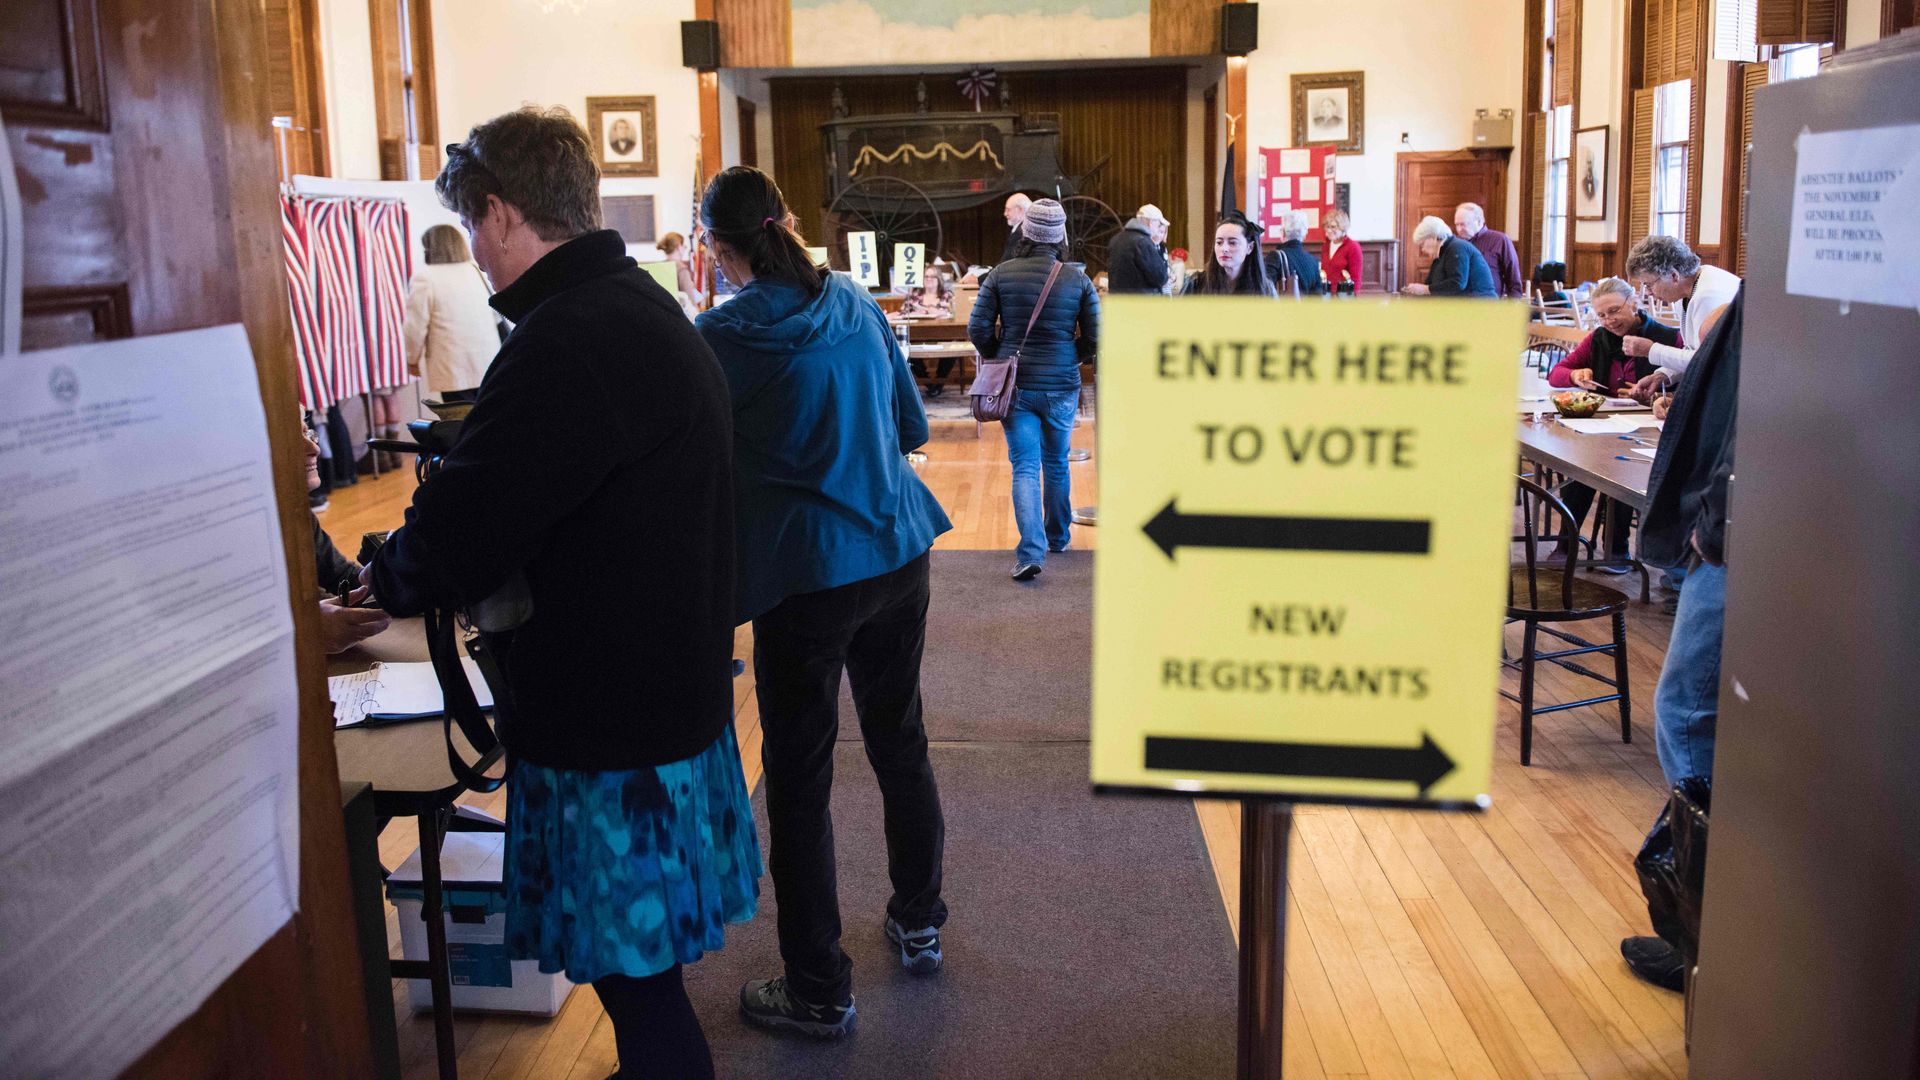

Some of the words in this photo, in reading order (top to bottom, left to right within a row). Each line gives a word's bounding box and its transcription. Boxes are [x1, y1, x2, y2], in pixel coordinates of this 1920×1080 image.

[1847, 170, 1897, 184] BALLOTS
[1804, 191, 1821, 202] THE
[1824, 191, 1881, 202] NOVEMBER
[1805, 210, 1846, 221] GENERAL
[1805, 228, 1824, 240] WILL
[1827, 228, 1839, 240] BE
[1815, 249, 1844, 261] AFTER
[1157, 339, 1316, 382] ENTER
[1336, 343, 1468, 385] HERE
[1197, 424, 1265, 465] TO
[1281, 427, 1418, 468] VOTE
[1249, 603, 1347, 637] NEW
[1161, 658, 1430, 699] REGISTRANTS
